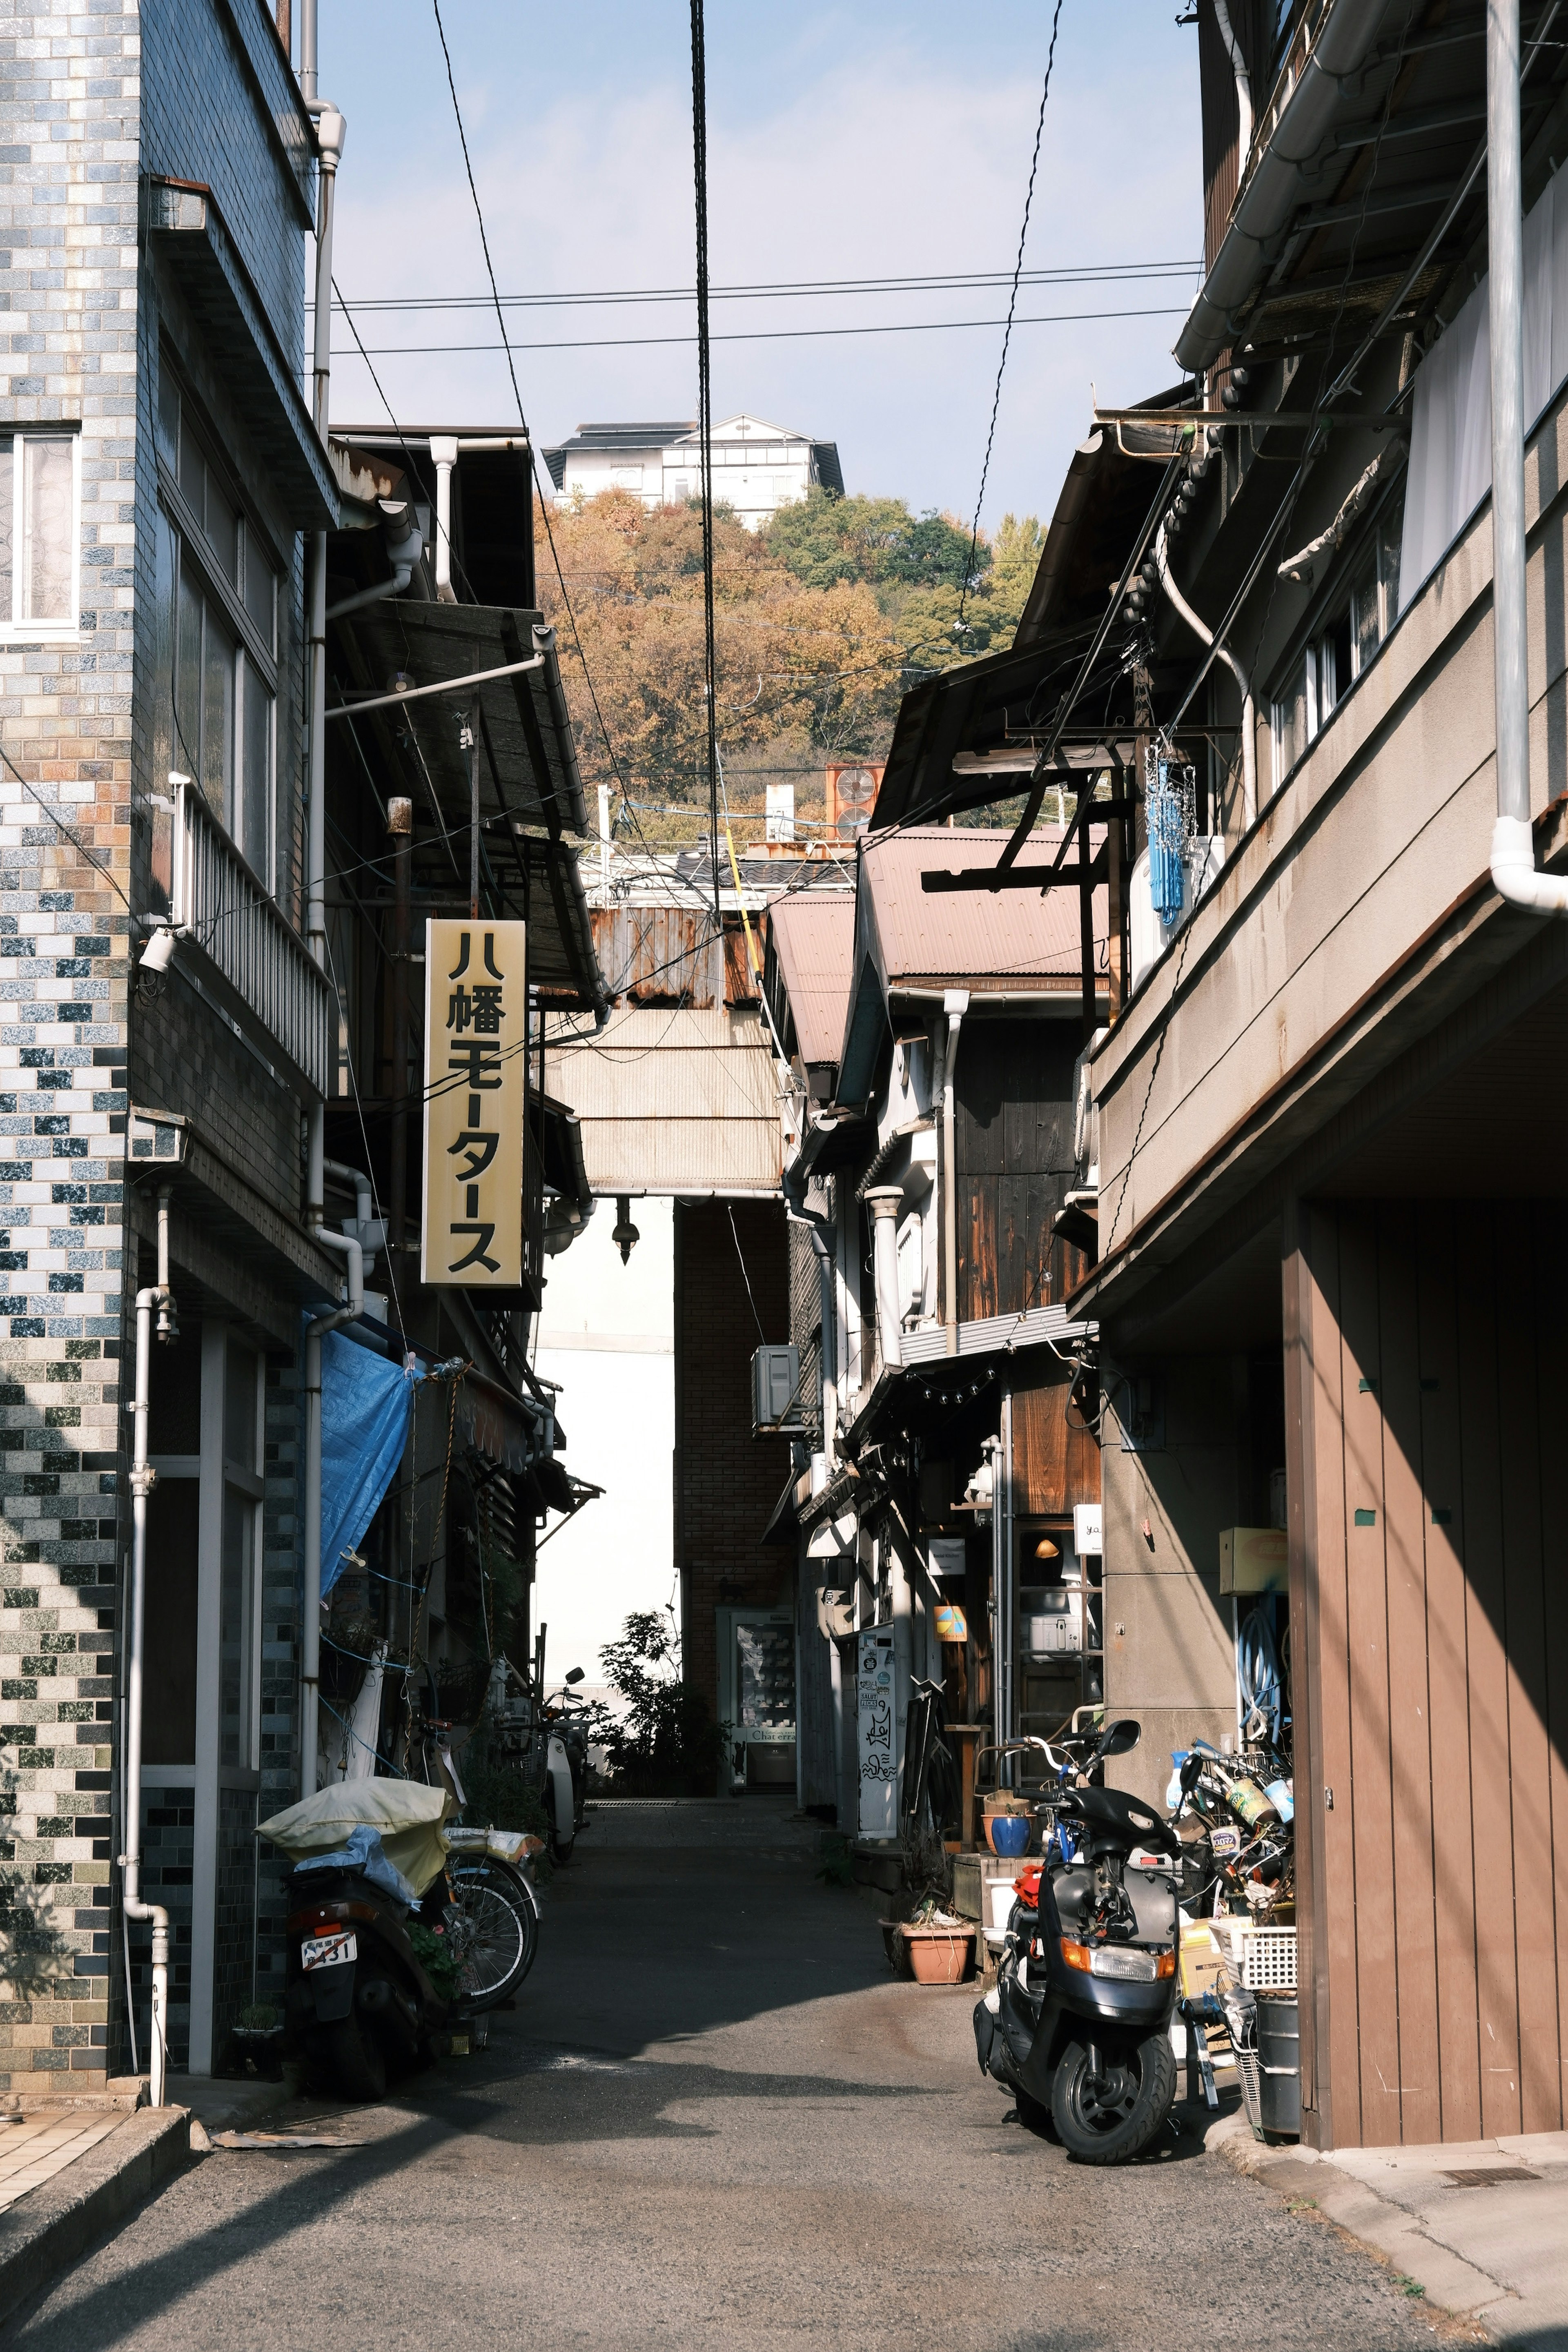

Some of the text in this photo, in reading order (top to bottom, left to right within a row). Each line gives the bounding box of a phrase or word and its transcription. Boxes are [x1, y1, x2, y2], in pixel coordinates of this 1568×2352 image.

[445, 932, 506, 1273] 八幡モータース
[752, 1730, 775, 1740] Chat
